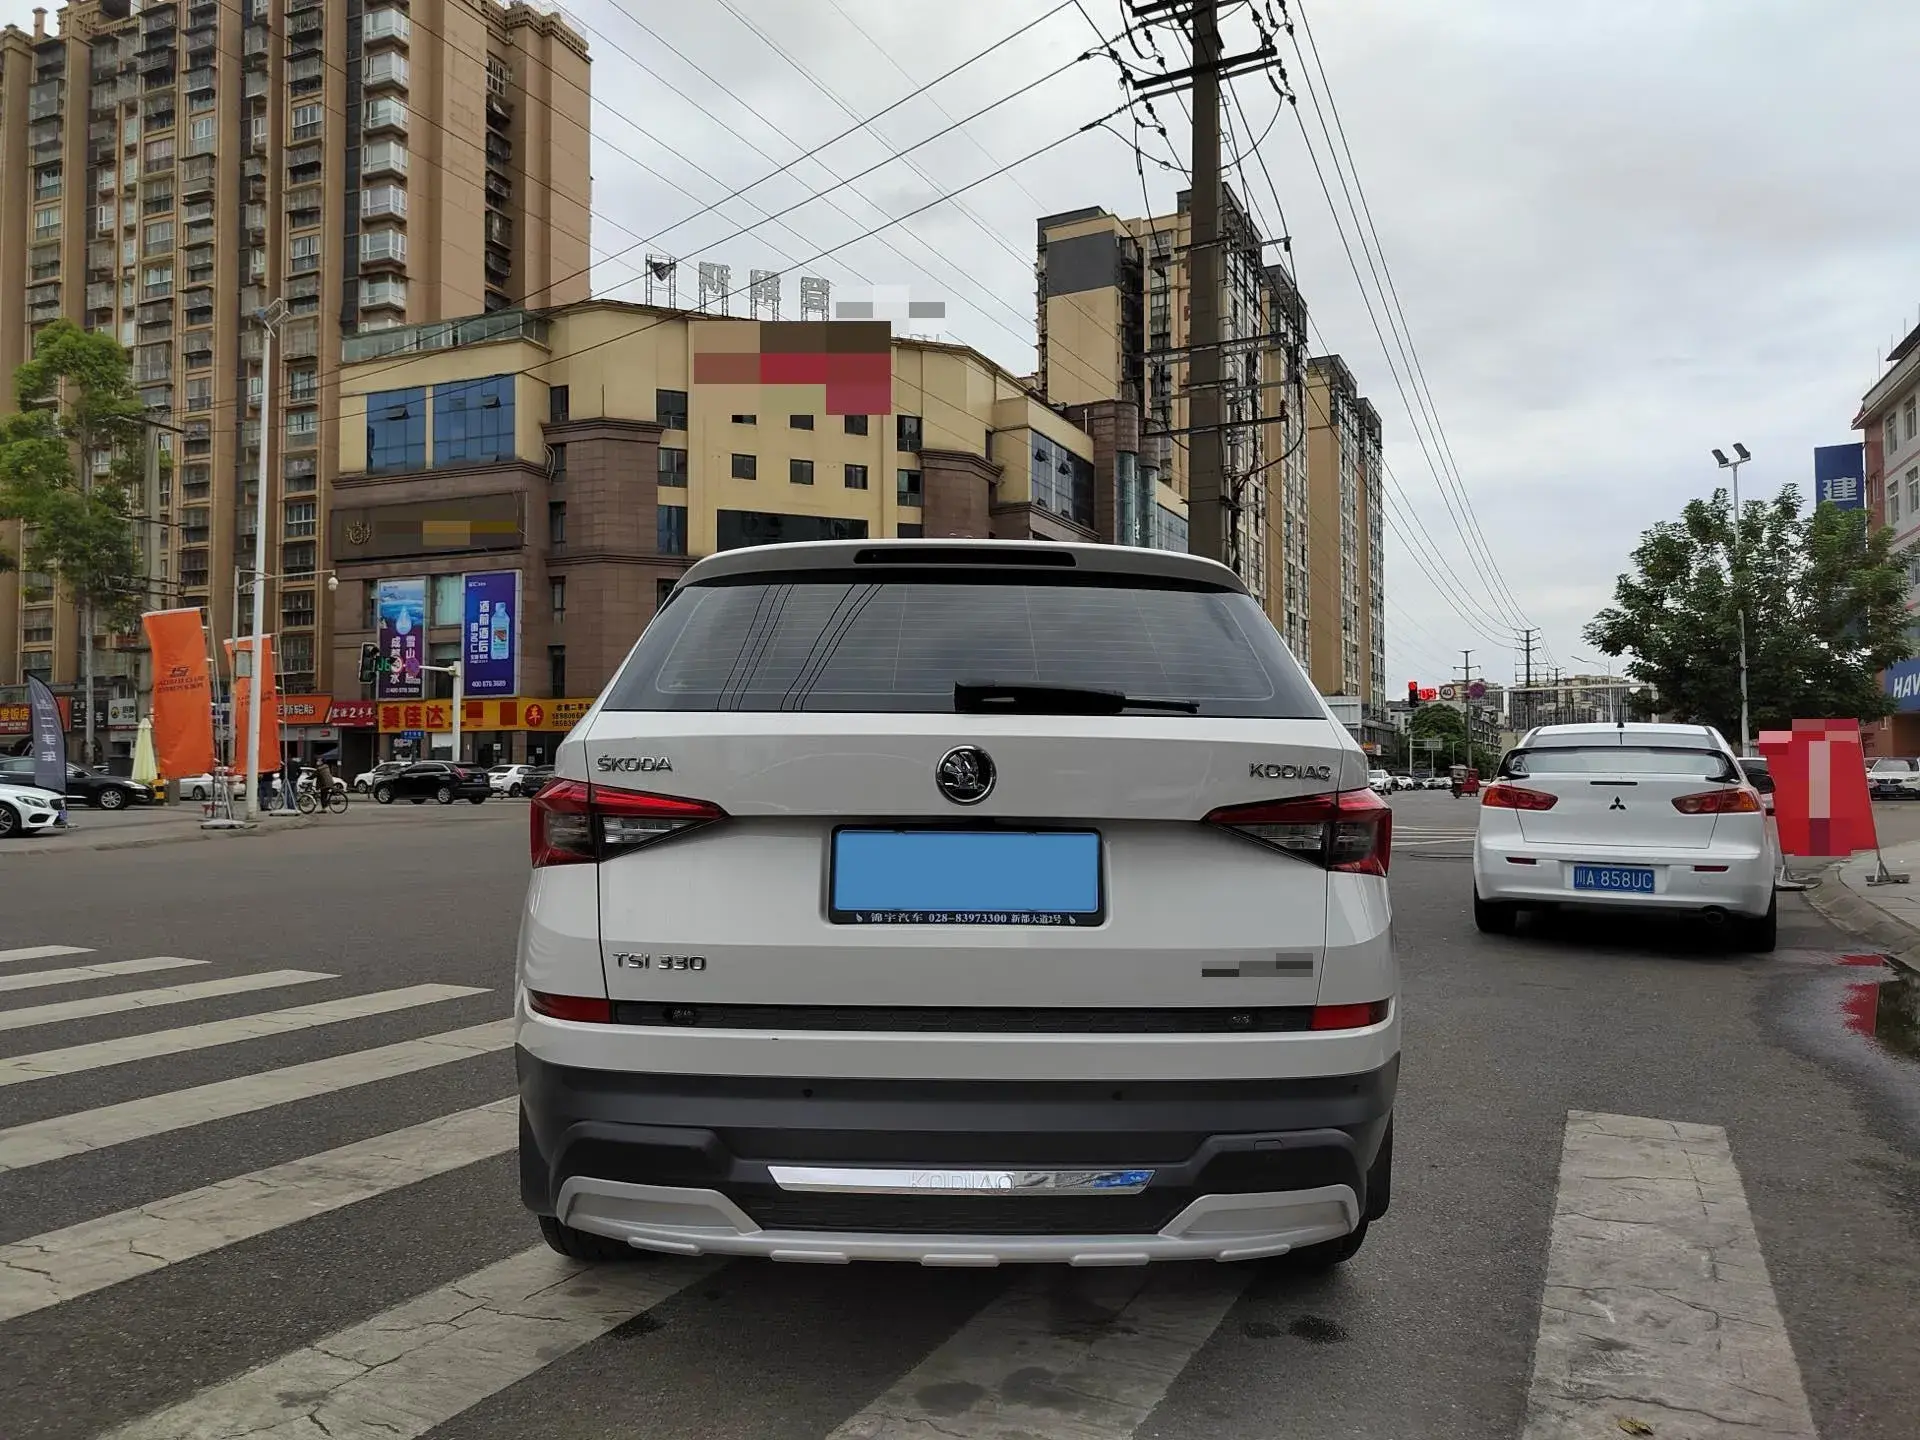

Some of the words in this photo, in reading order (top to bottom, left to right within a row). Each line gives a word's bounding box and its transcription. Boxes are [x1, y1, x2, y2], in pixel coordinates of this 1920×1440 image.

[1823, 477, 1858, 502] 建
[1893, 674, 1920, 698] HAV
[597, 755, 674, 772] ŠKODA
[1249, 763, 1332, 782] KODIAQ
[1601, 871, 1652, 889] 858UC
[928, 913, 1008, 924] 028-83973300
[613, 952, 650, 970] TSI
[657, 954, 707, 972] 330
